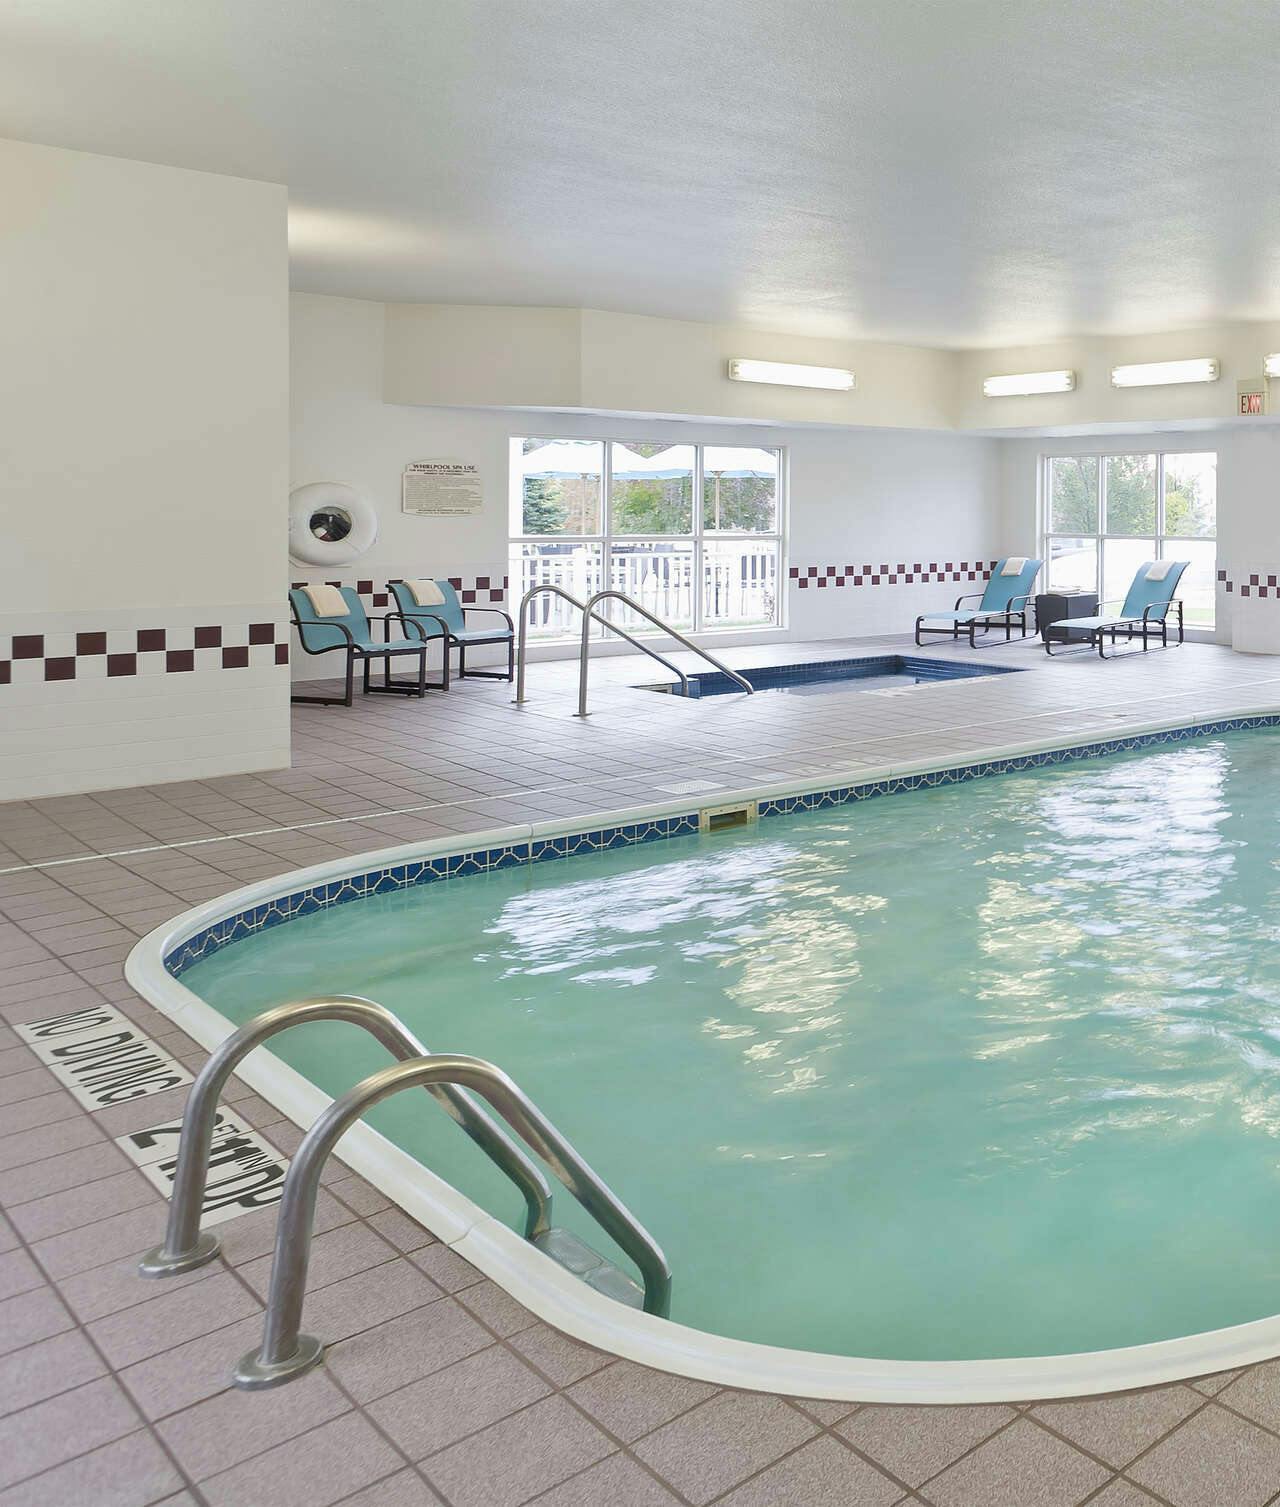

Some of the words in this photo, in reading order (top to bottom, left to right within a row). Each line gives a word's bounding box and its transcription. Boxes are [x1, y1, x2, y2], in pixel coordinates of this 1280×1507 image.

[1241, 394, 1261, 413] EXIT
[25, 1006, 113, 1036] NO
[51, 1031, 182, 1106] DIVING
